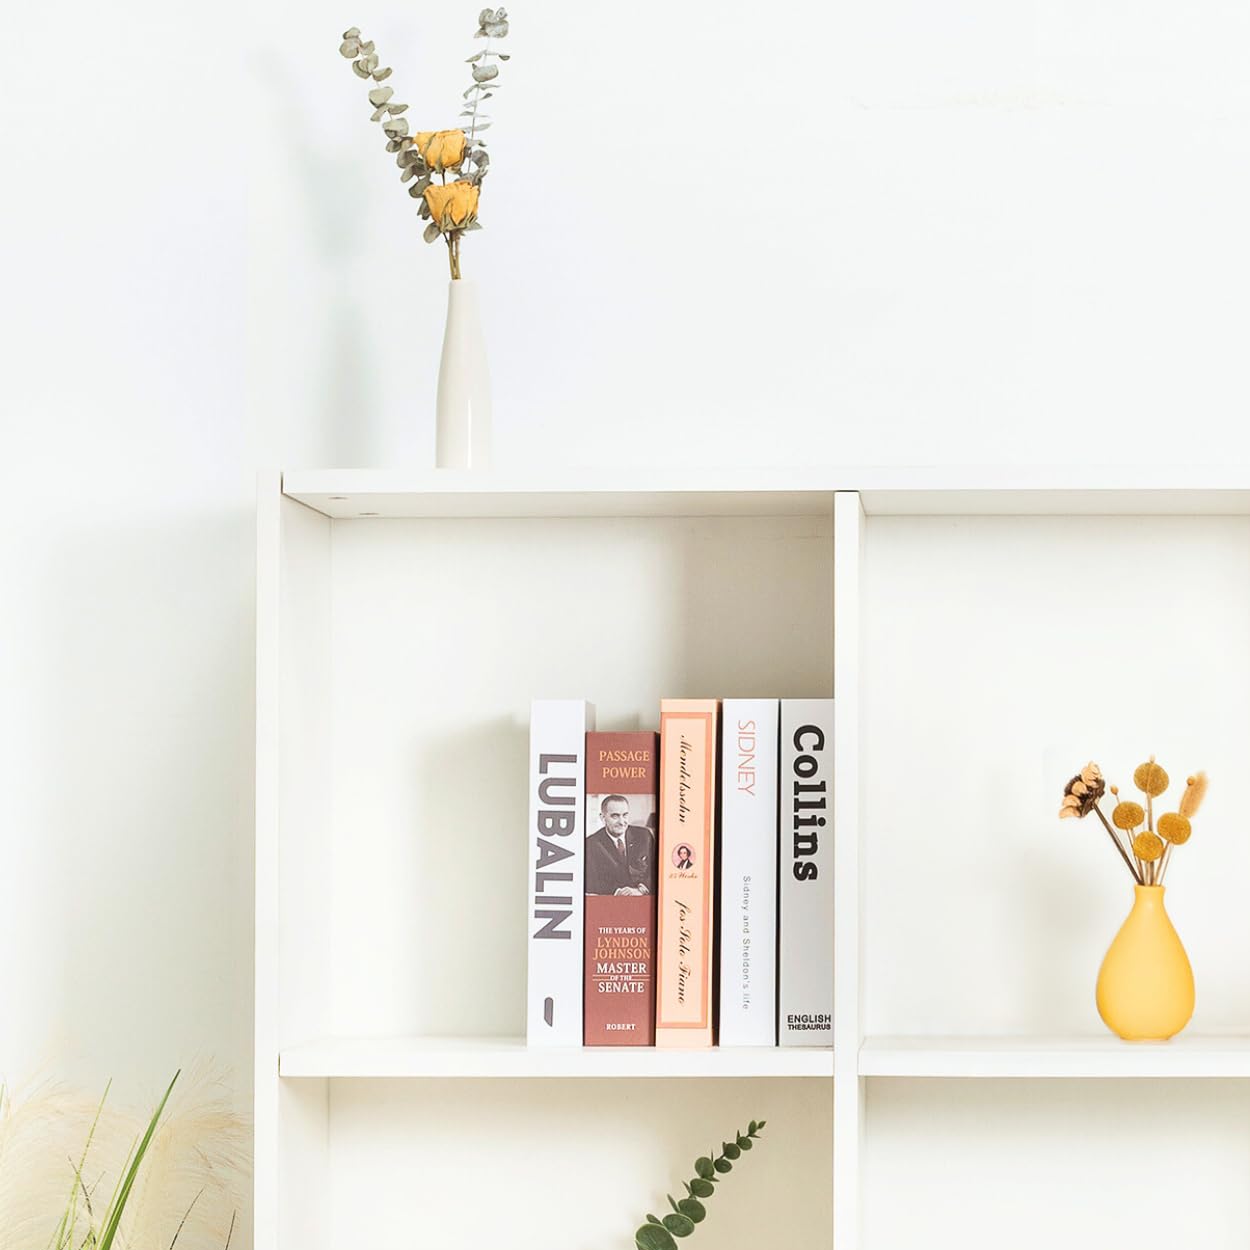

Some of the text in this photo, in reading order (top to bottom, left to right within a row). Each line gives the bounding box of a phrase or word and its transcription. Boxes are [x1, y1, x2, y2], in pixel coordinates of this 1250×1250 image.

[599, 750, 650, 762] PASSAGE
[737, 719, 756, 796] SIDNEY
[602, 767, 646, 779] POWER
[793, 724, 826, 882] Collins
[533, 753, 578, 940] LUBALIN
[741, 875, 752, 911] Sidney
[742, 915, 751, 934] and
[597, 937, 648, 948] LYNDON
[592, 948, 651, 960] JOHNSON
[597, 963, 647, 974] MASTER
[598, 982, 645, 993] SENATE
[742, 993, 750, 1010] life
[787, 1014, 831, 1023] ENGLISH
[606, 1023, 636, 1031] ROBERT
[787, 1023, 831, 1031] THESAURUS
